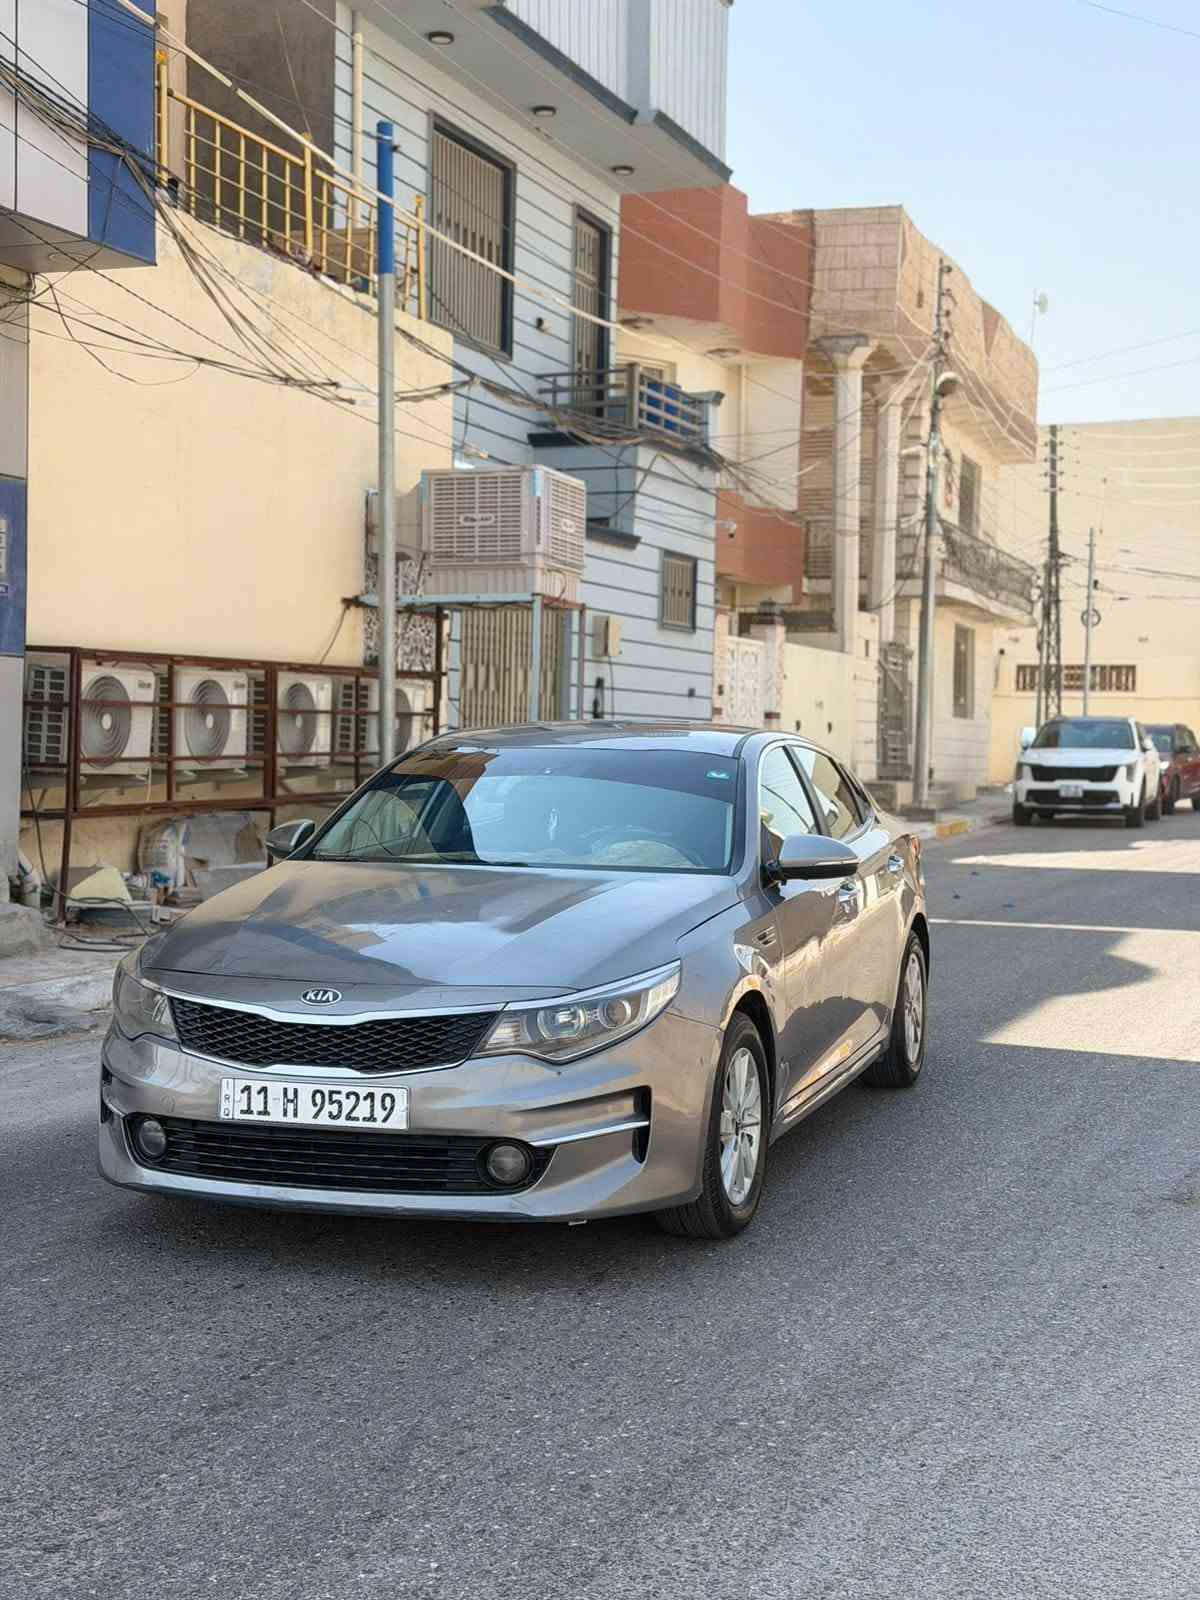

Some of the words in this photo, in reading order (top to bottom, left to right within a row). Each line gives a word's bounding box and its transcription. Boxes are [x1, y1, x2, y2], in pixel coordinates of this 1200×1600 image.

[306, 990, 333, 1002] KIA
[239, 1084, 271, 1117] 11
[282, 1087, 298, 1118] H
[311, 1089, 396, 1123] 95219
